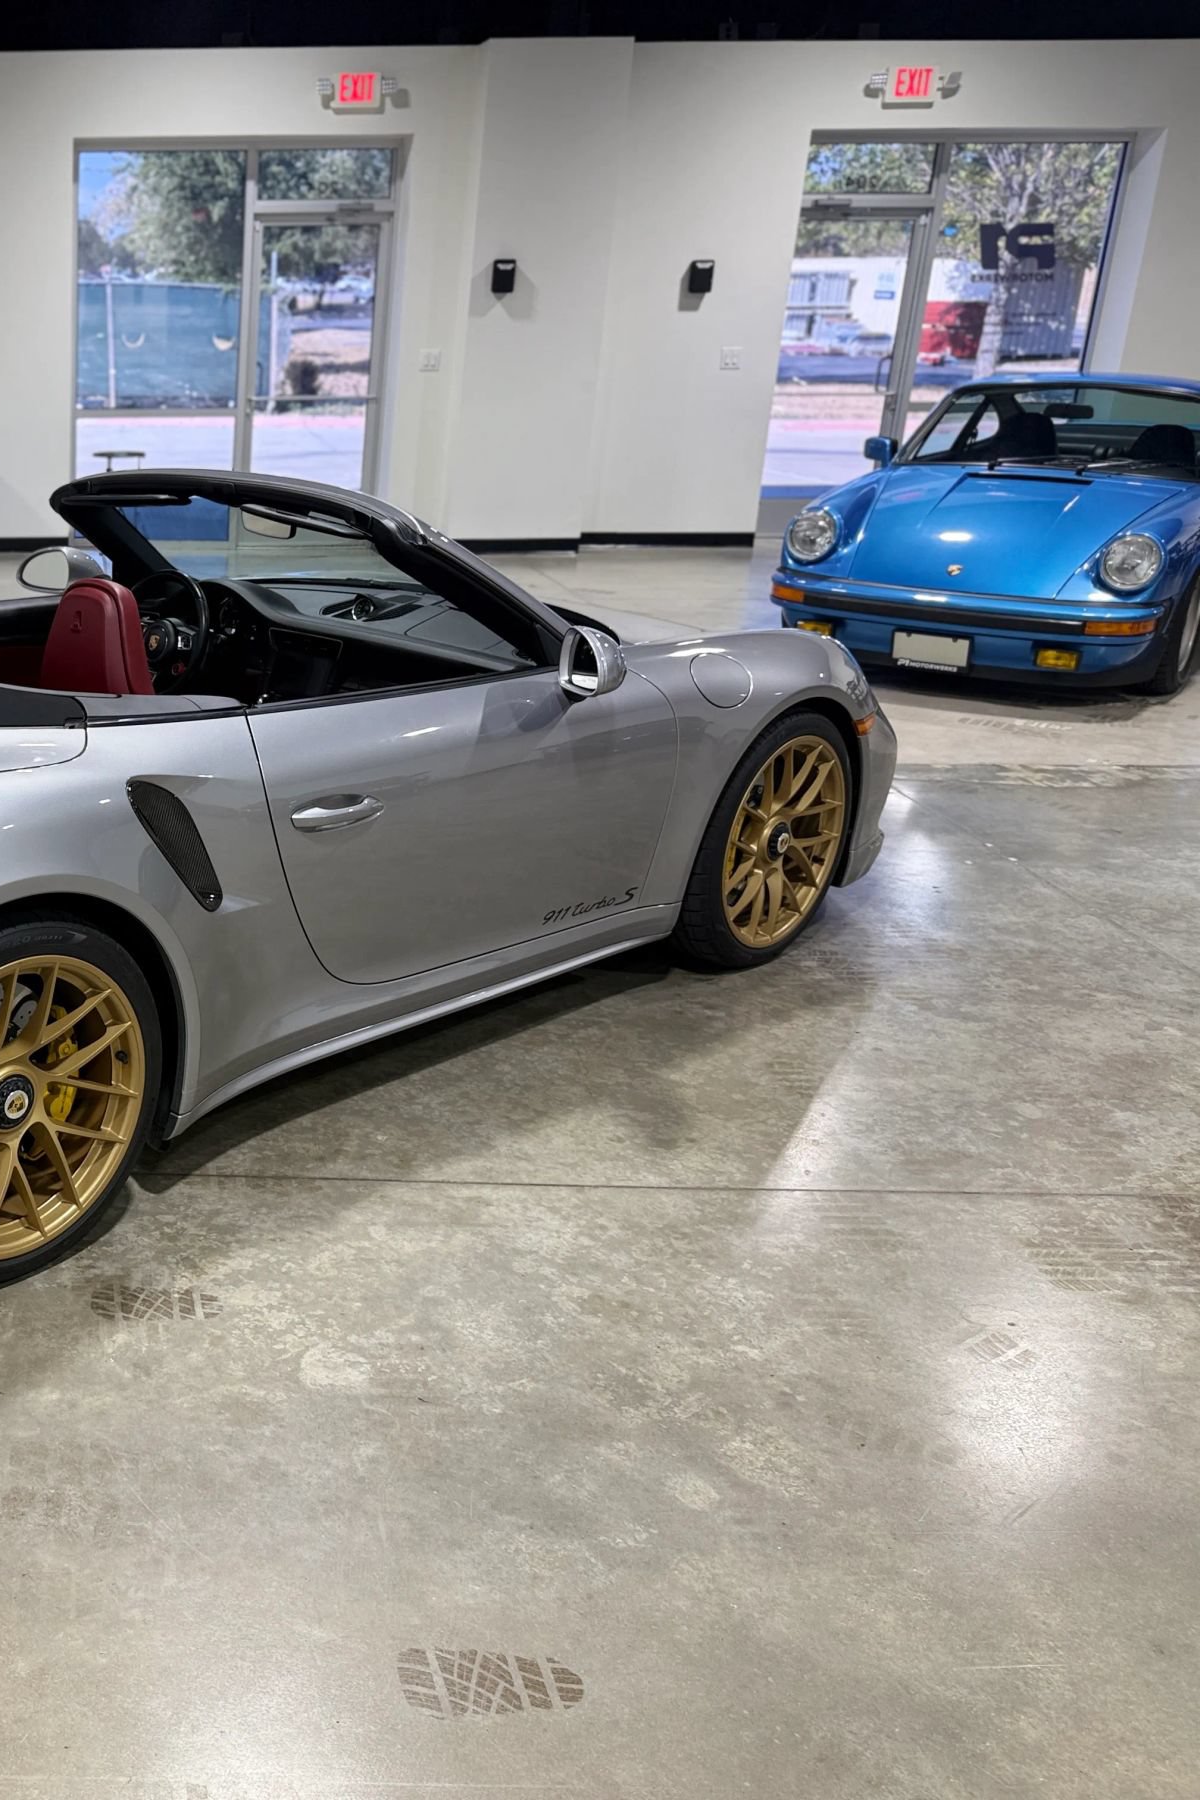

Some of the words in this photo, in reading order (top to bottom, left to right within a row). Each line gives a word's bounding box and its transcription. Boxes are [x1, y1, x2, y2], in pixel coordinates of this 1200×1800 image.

[339, 72, 376, 103] EXIT
[894, 67, 933, 97] EXIT
[542, 905, 571, 926] 911
[615, 886, 640, 906] S
